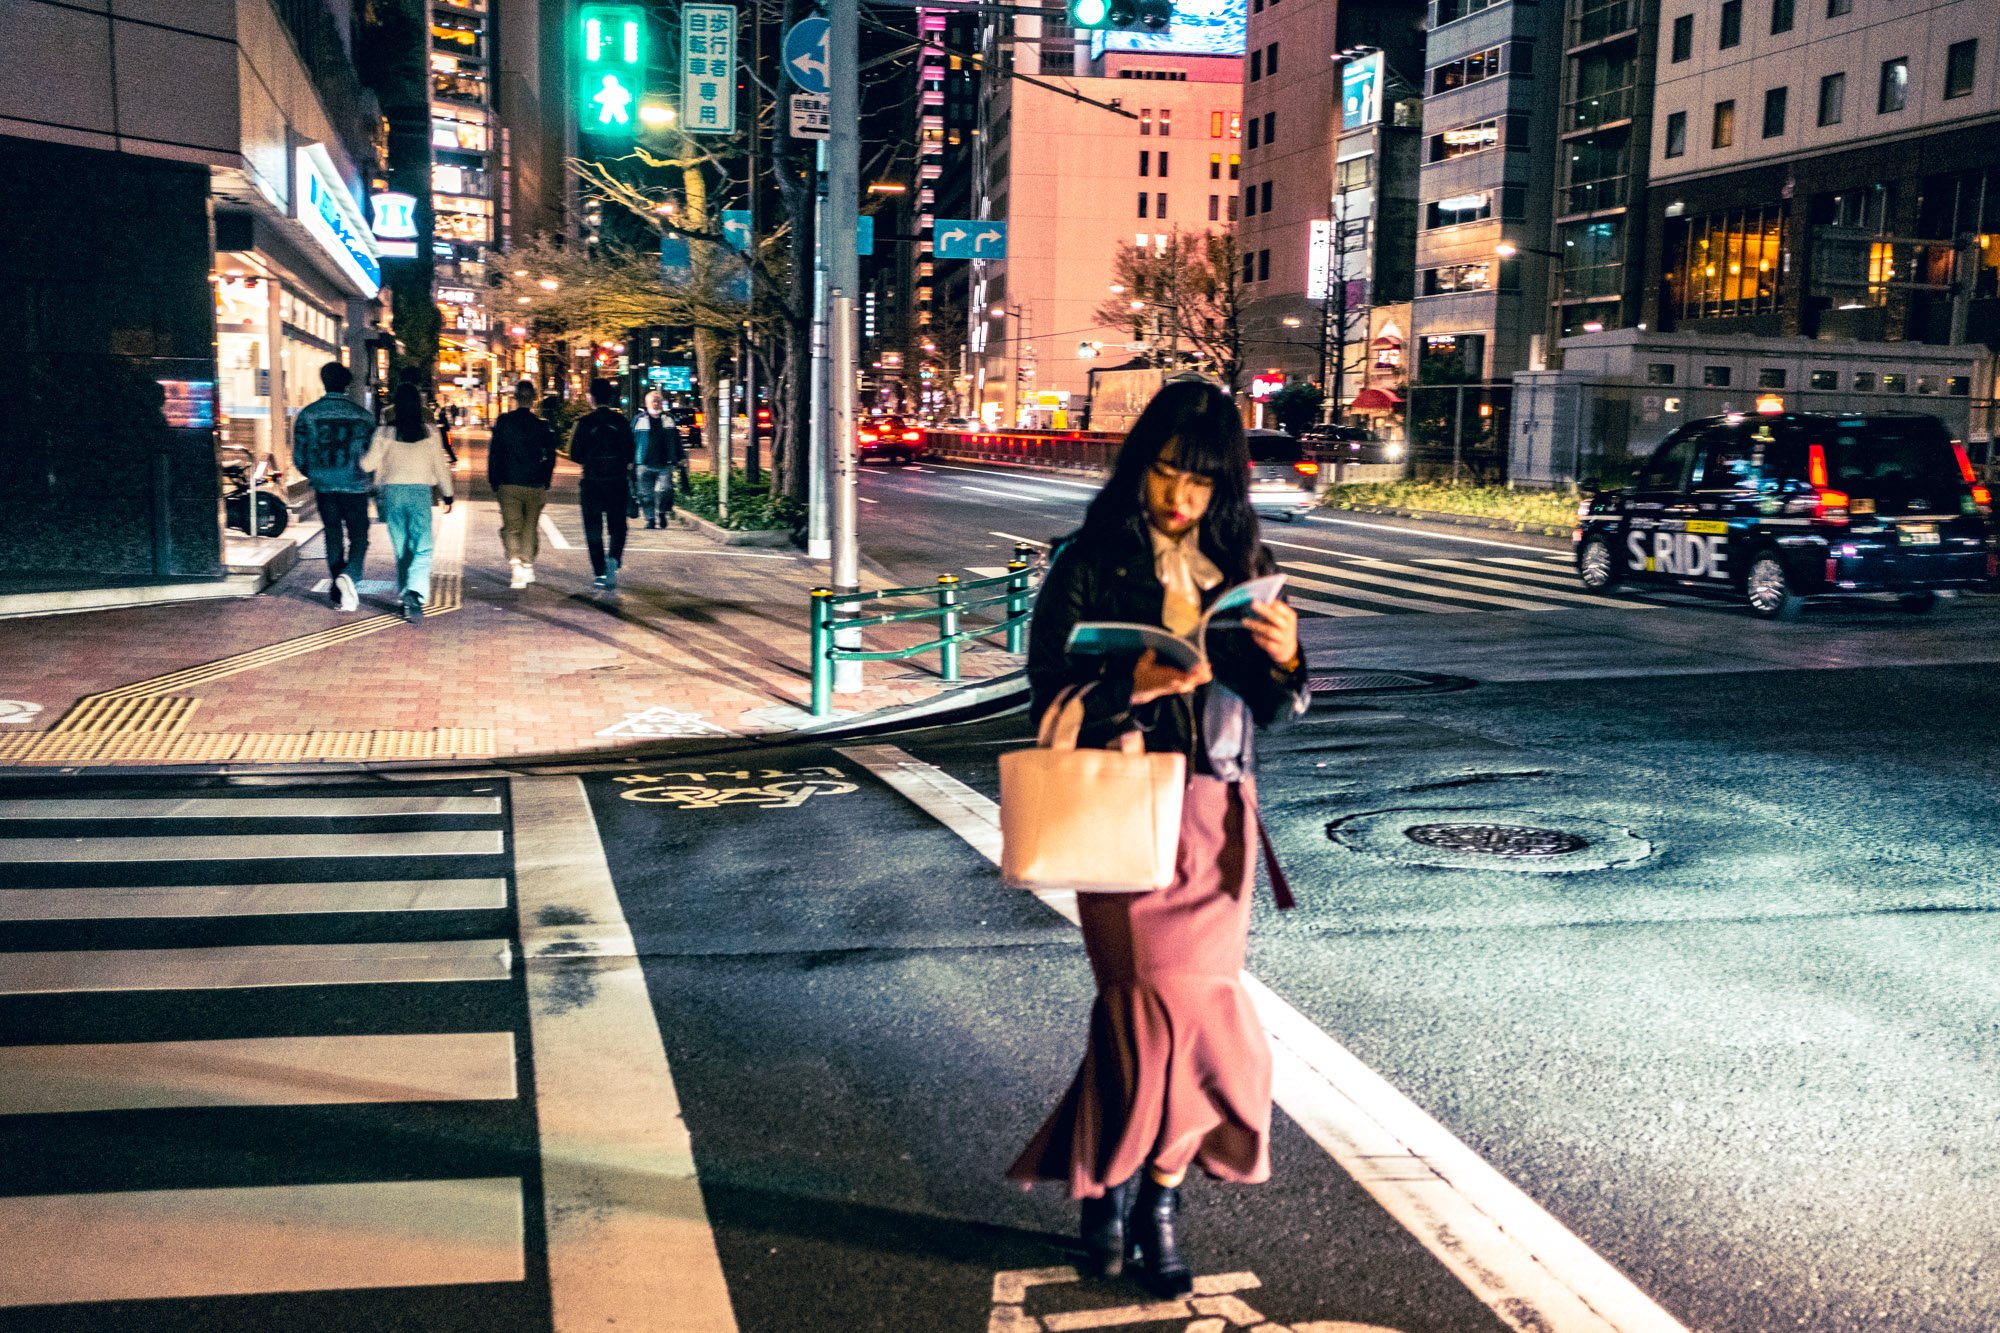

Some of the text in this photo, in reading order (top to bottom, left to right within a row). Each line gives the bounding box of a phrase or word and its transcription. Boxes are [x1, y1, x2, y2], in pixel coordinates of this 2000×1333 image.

[689, 13, 707, 76] 自転車
[710, 13, 728, 78] 歩行者
[699, 82, 718, 124] 専用
[1626, 530, 1730, 579] S.RIDE
